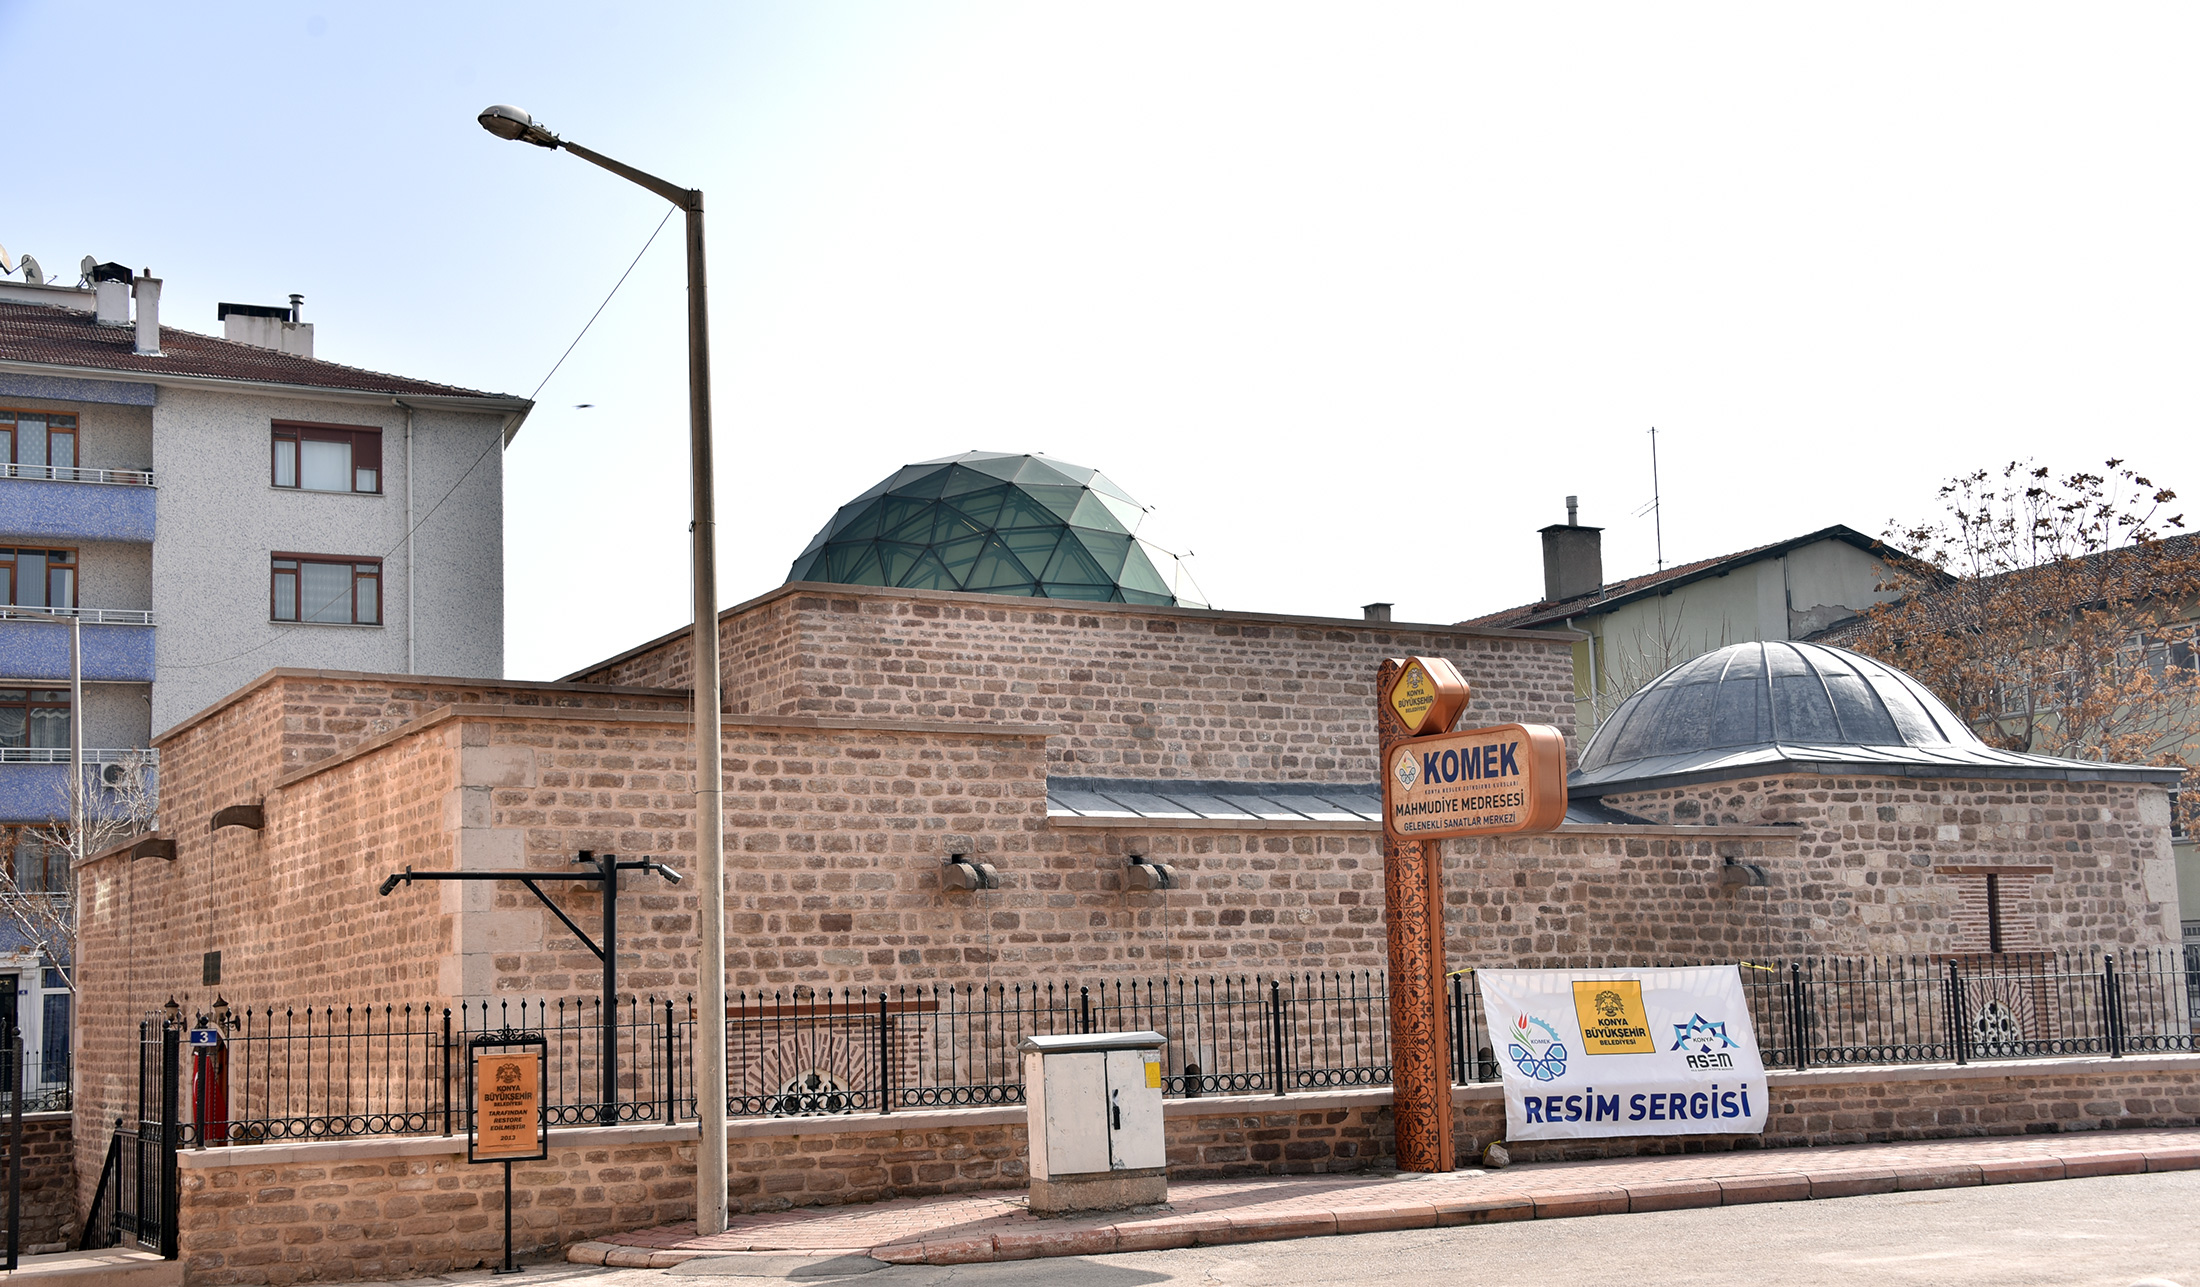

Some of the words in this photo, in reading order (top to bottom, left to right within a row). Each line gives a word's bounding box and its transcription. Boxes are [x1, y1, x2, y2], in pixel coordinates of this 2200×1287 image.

[1406, 689, 1425, 697] KONYA
[1424, 742, 1519, 784] KOMEK
[1395, 796, 1459, 817] MAHMUDİYE
[1461, 788, 1524, 811] MEDRESESİ
[1404, 819, 1443, 832] GELENEKLİ
[1444, 815, 1482, 828] SANATLAR
[1483, 812, 1516, 825] MERKEZİ
[1597, 1018, 1629, 1027] KONYA
[199, 1031, 208, 1043] 3
[1585, 1026, 1646, 1039] BÜYÜKŞEHİR
[1599, 1038, 1637, 1046] BELEDİYESİ
[1686, 1053, 1733, 1069] ASEM
[484, 1092, 533, 1102] BÜYÜKŞEHİR
[1524, 1087, 1620, 1124] RESİM
[1628, 1083, 1752, 1122] SERGİSİ
